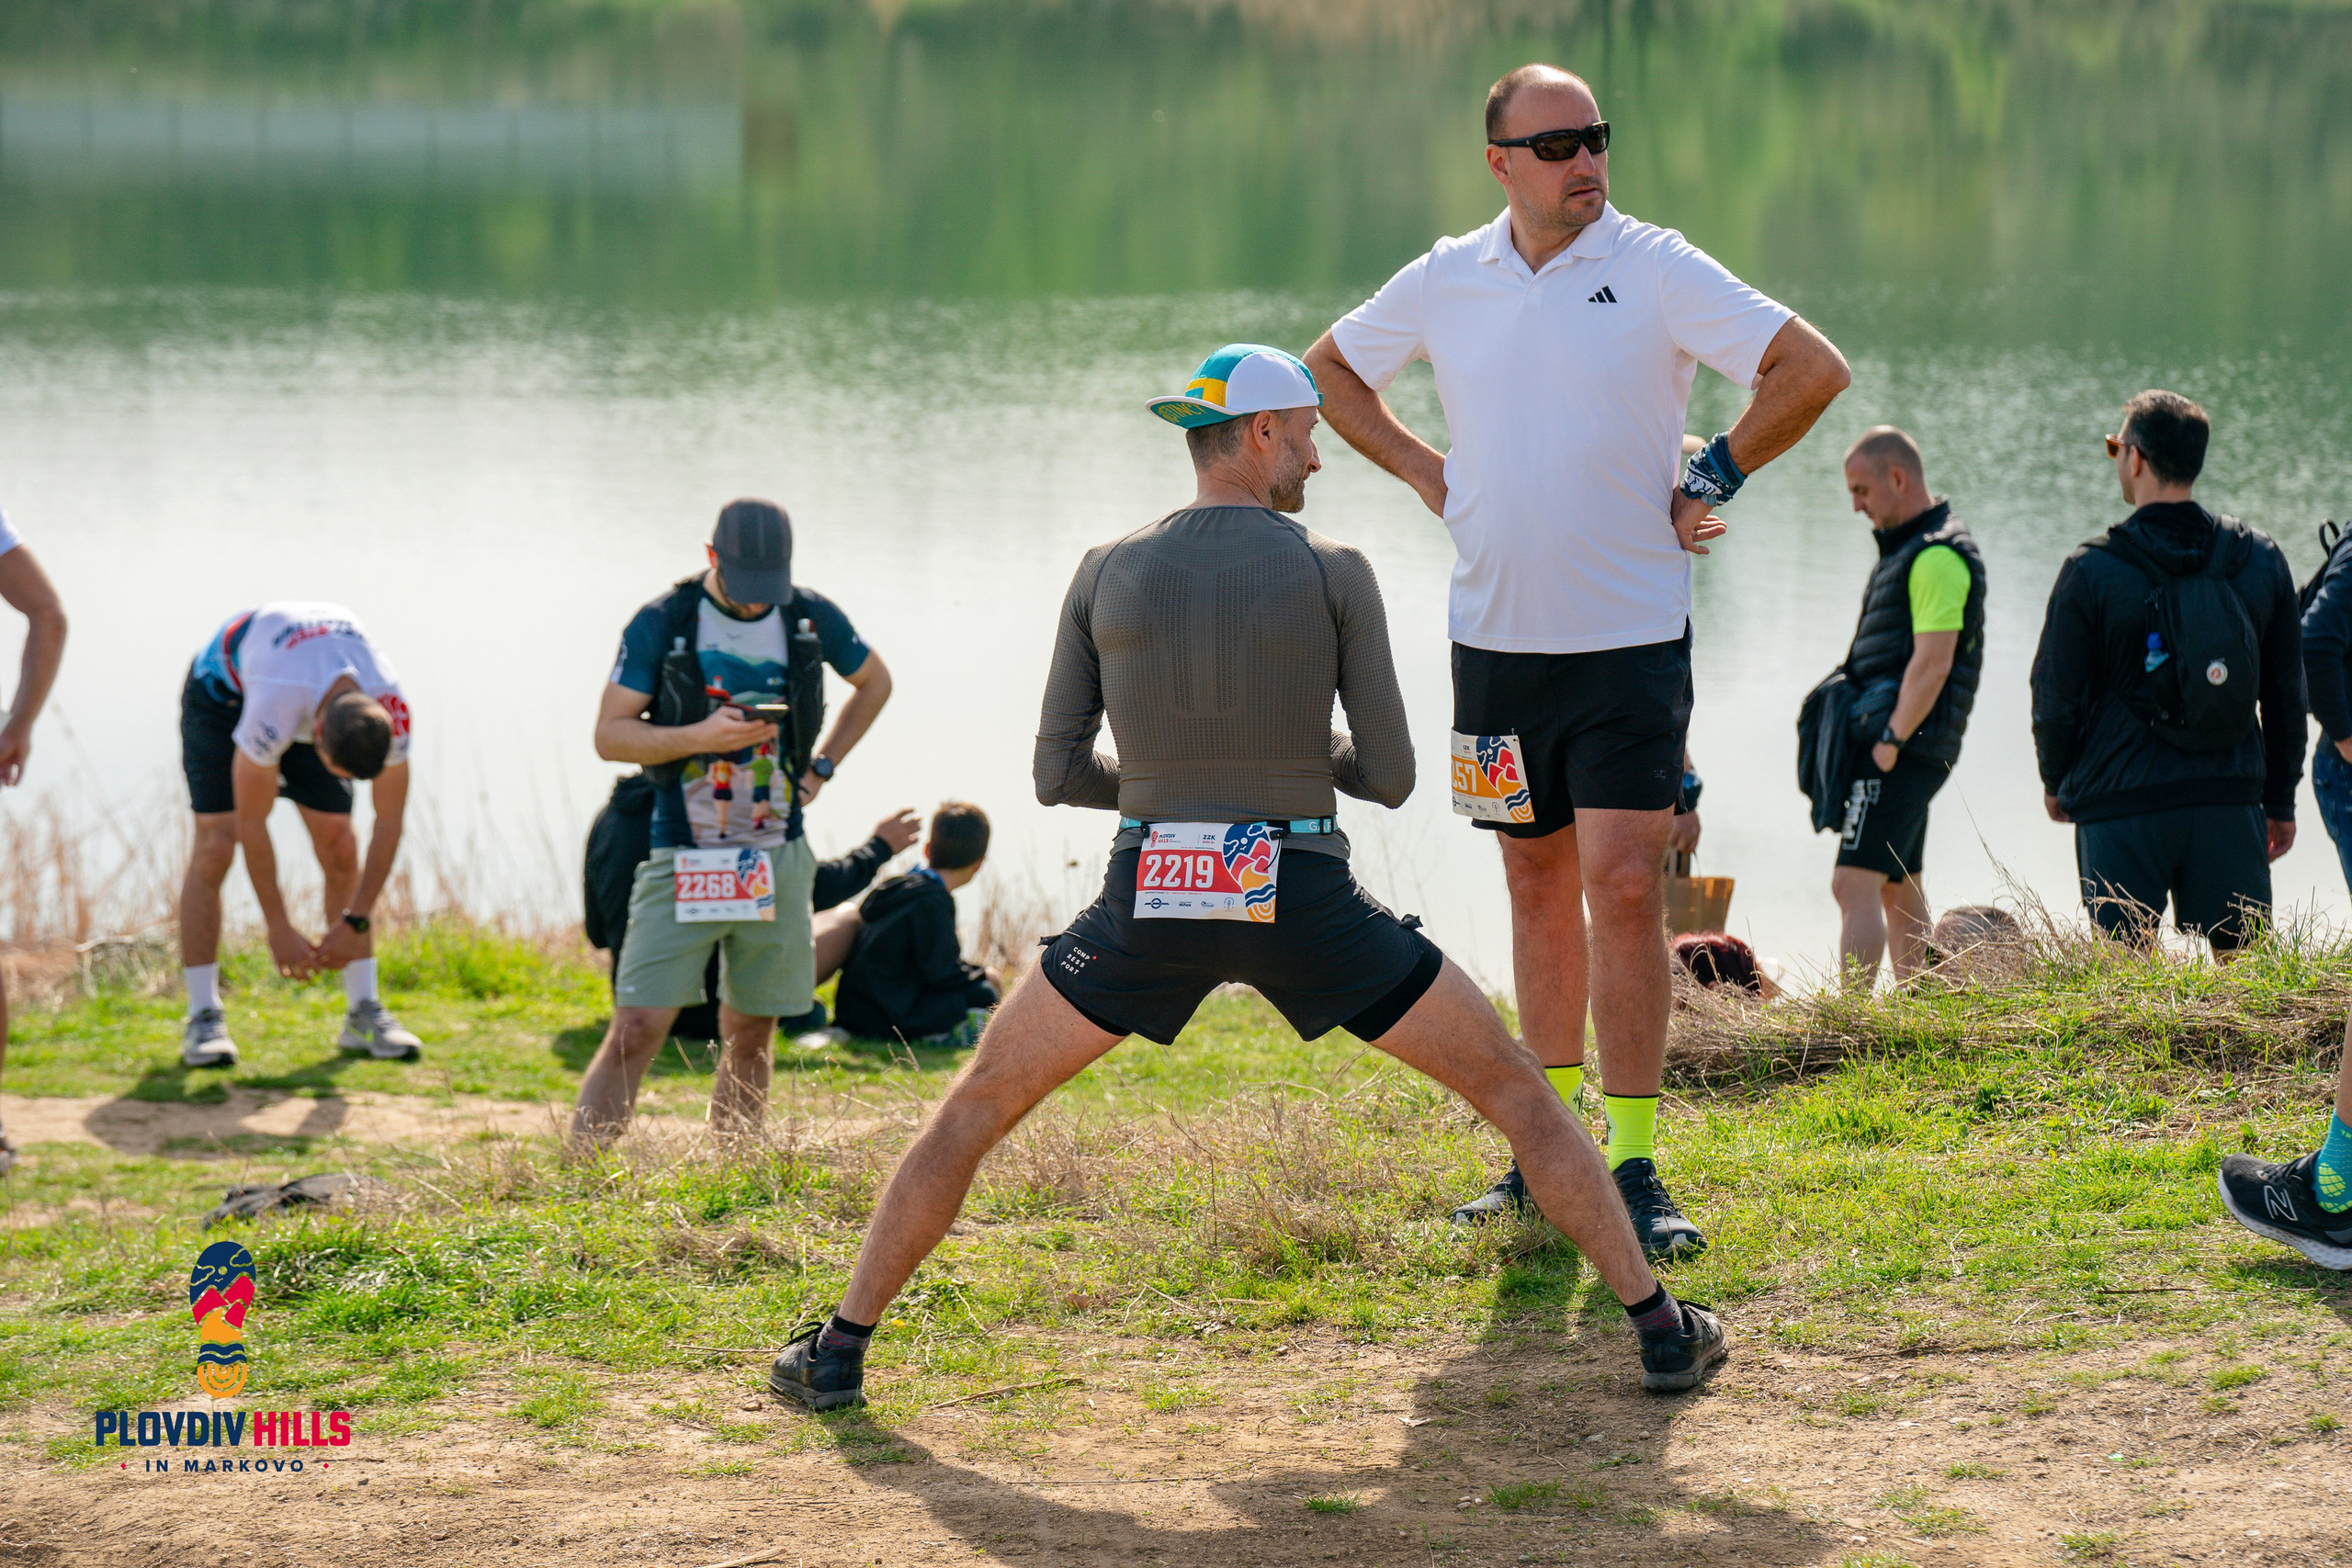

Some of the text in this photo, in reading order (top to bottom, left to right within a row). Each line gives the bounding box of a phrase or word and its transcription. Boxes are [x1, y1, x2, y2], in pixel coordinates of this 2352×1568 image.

[1143, 854, 1215, 888] 2219
[678, 874, 736, 899] 2268
[1067, 953, 1086, 968] RESS
[1073, 946, 1091, 961] COMP
[1060, 961, 1080, 975] PORT
